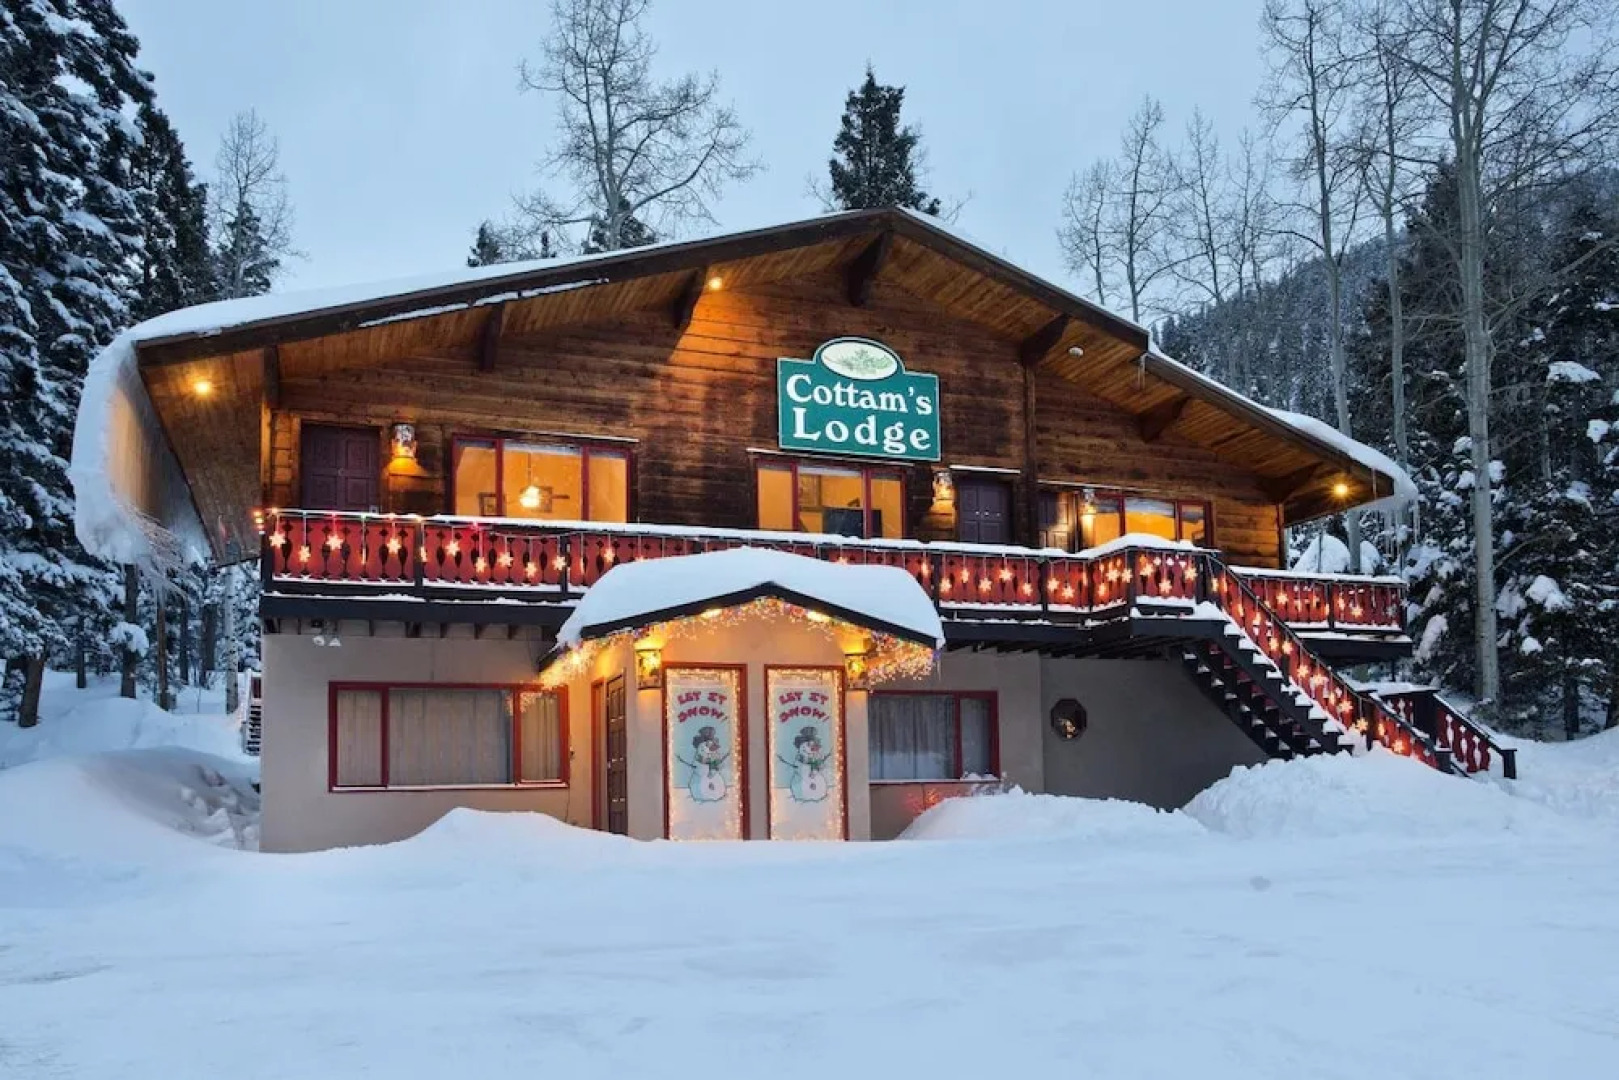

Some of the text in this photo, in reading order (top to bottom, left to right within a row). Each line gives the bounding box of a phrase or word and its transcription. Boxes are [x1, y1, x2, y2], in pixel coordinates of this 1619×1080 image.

[786, 374, 933, 415] Cottam's
[792, 407, 932, 454] Lodge
[677, 691, 727, 705] LET IT
[778, 691, 829, 705] LET IT
